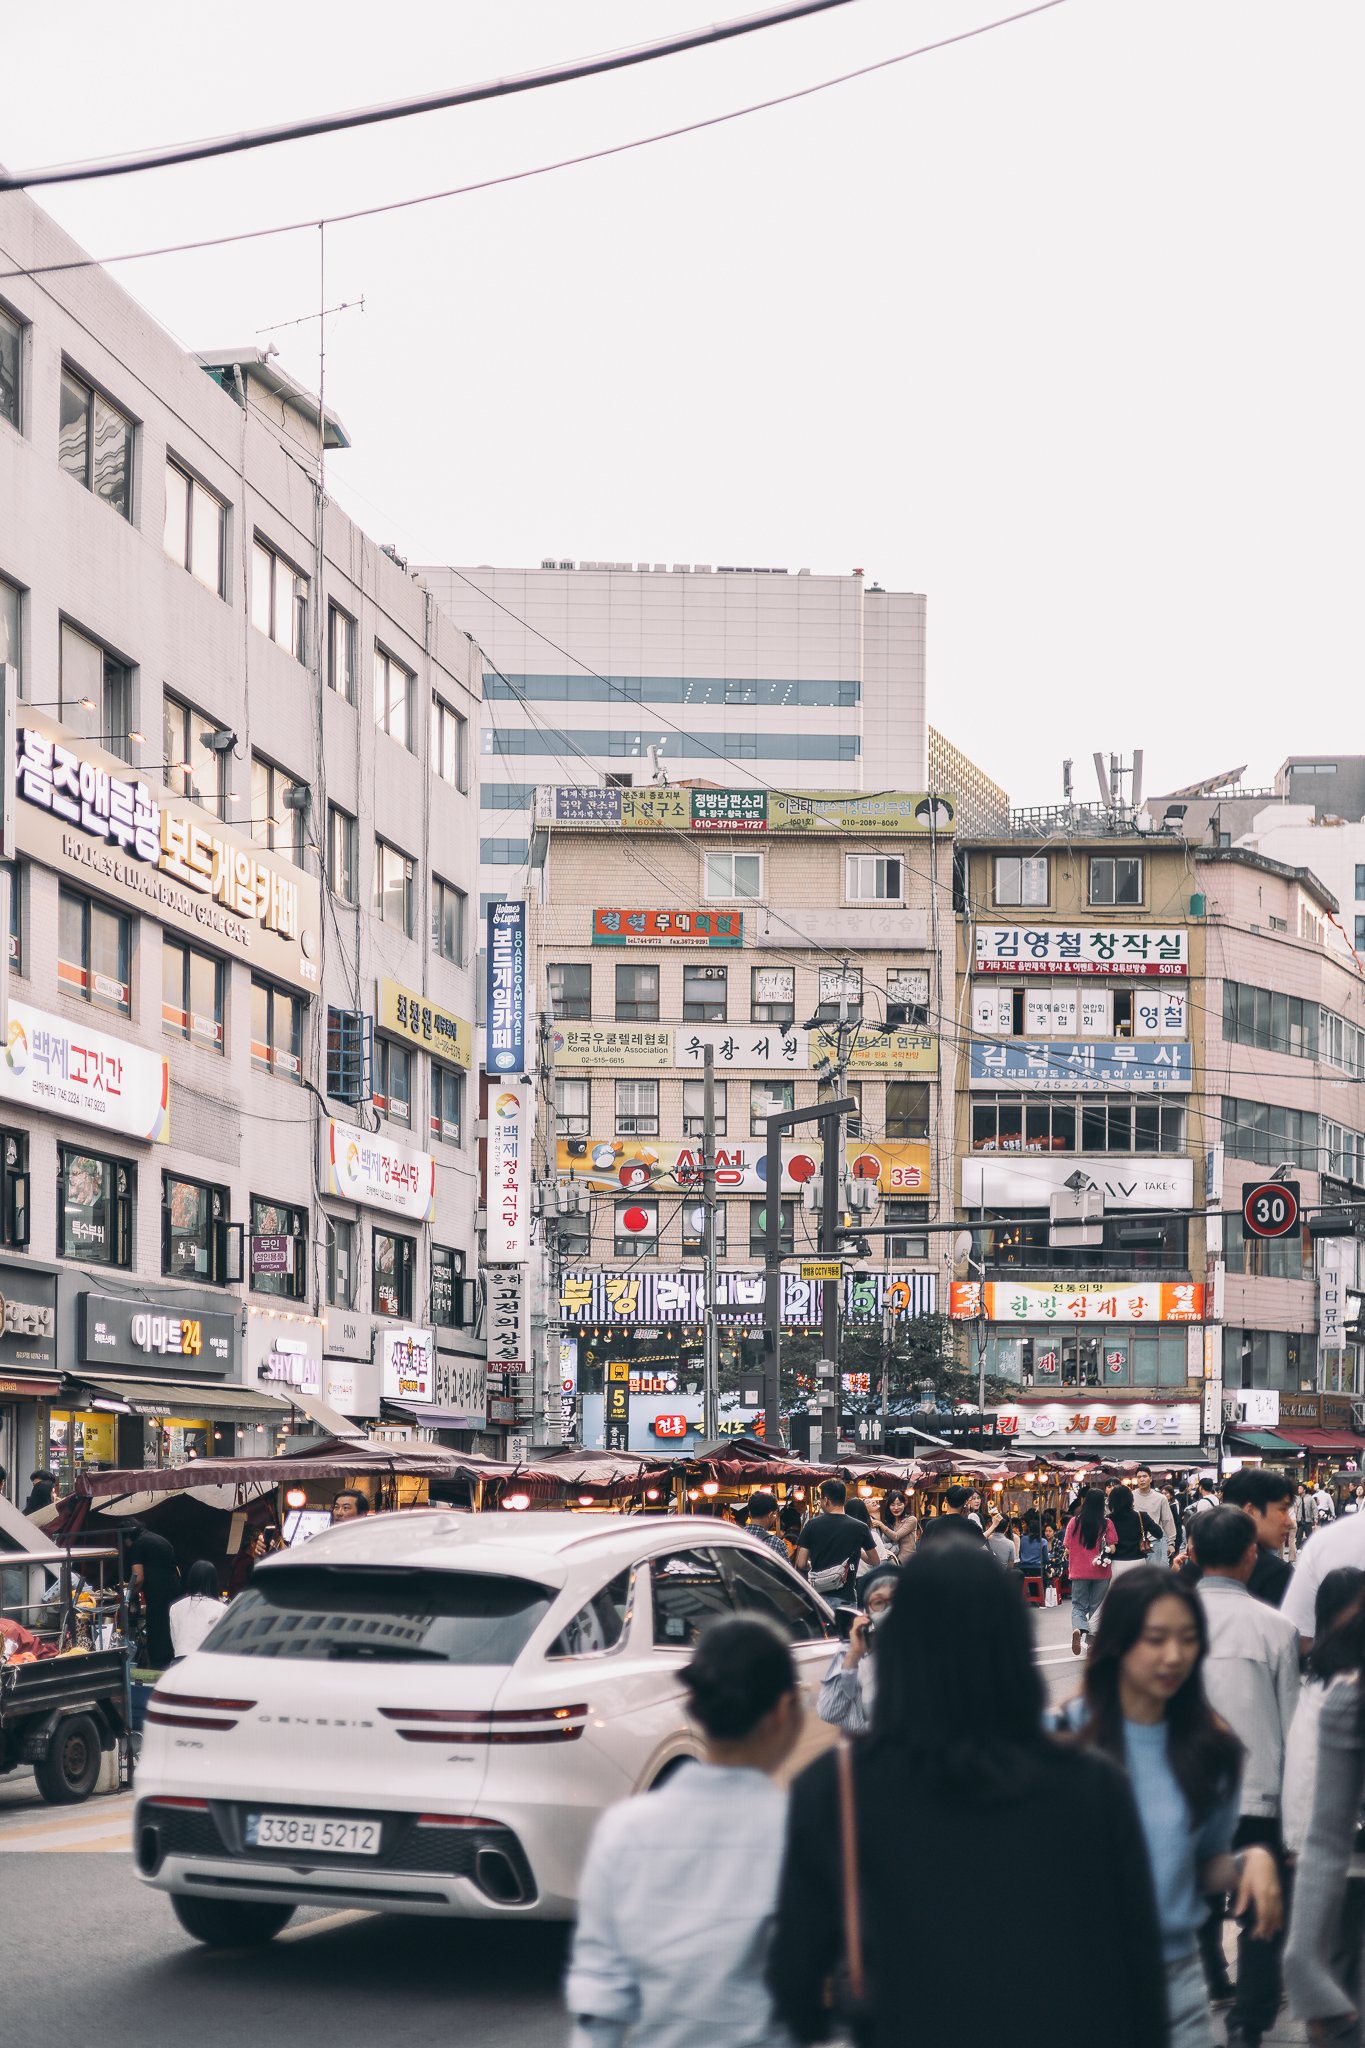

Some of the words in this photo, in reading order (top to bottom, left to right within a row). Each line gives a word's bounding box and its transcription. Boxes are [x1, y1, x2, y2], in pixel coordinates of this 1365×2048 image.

[560, 800, 581, 809] 국악
[642, 802, 685, 817] 연구소
[729, 794, 763, 809] 판소리
[695, 819, 763, 829] 010-3719-1727
[159, 809, 298, 942] 보드게임카페
[62, 834, 114, 877] HOLMES
[126, 865, 158, 899] LUPIN
[160, 883, 194, 918] BOARD
[195, 902, 224, 934] GAME
[224, 918, 251, 947] CAFE
[514, 931, 523, 974] BOARD
[994, 931, 1081, 958] 김영철
[1089, 932, 1181, 960] 창작실
[986, 962, 1000, 971] 기타
[1002, 962, 1016, 971] 지도
[1018, 962, 1047, 972] 음반제작
[1159, 965, 1183, 974] 501호
[492, 928, 513, 1049] 보드게임카페
[514, 975, 523, 1010] GAME
[1169, 995, 1185, 1006] TV
[1140, 1006, 1182, 1029] 영철
[514, 1011, 523, 1046] CAFE
[567, 1032, 669, 1046] 한국우쿨렐레협회
[897, 1036, 932, 1050] 연구원
[567, 1046, 590, 1054] Korea
[593, 1046, 622, 1054] Ukulele
[624, 1046, 669, 1054] Association
[498, 1055, 513, 1066] 3F
[361, 1148, 419, 1194] 백제정육식당
[503, 1125, 519, 1227] 백제정육식당
[890, 1166, 923, 1188] 3층
[1257, 1198, 1285, 1223] 30
[71, 1220, 105, 1244] 특수부위
[261, 1239, 280, 1251] 무인
[506, 1241, 518, 1250] 2F
[256, 1253, 285, 1262] 성인용품
[490, 1274, 523, 1285] 은하
[803, 1266, 815, 1277] 방범용
[815, 1267, 827, 1276] CCTV
[559, 1279, 641, 1314] 부킹
[785, 1280, 911, 1315] 250
[1053, 1283, 1104, 1293] 전통의맛
[1010, 1295, 1149, 1318] 한방삼계탕
[493, 1288, 521, 1360] 고전의상실
[131, 1314, 202, 1355] 이마트24
[491, 1363, 523, 1372] 742-2557
[613, 1389, 625, 1407] 5
[658, 1417, 684, 1435] 전통
[1065, 1413, 1117, 1436] 치킨
[258, 1715, 375, 1728] GENESIS
[321, 1823, 374, 1849] 5212
